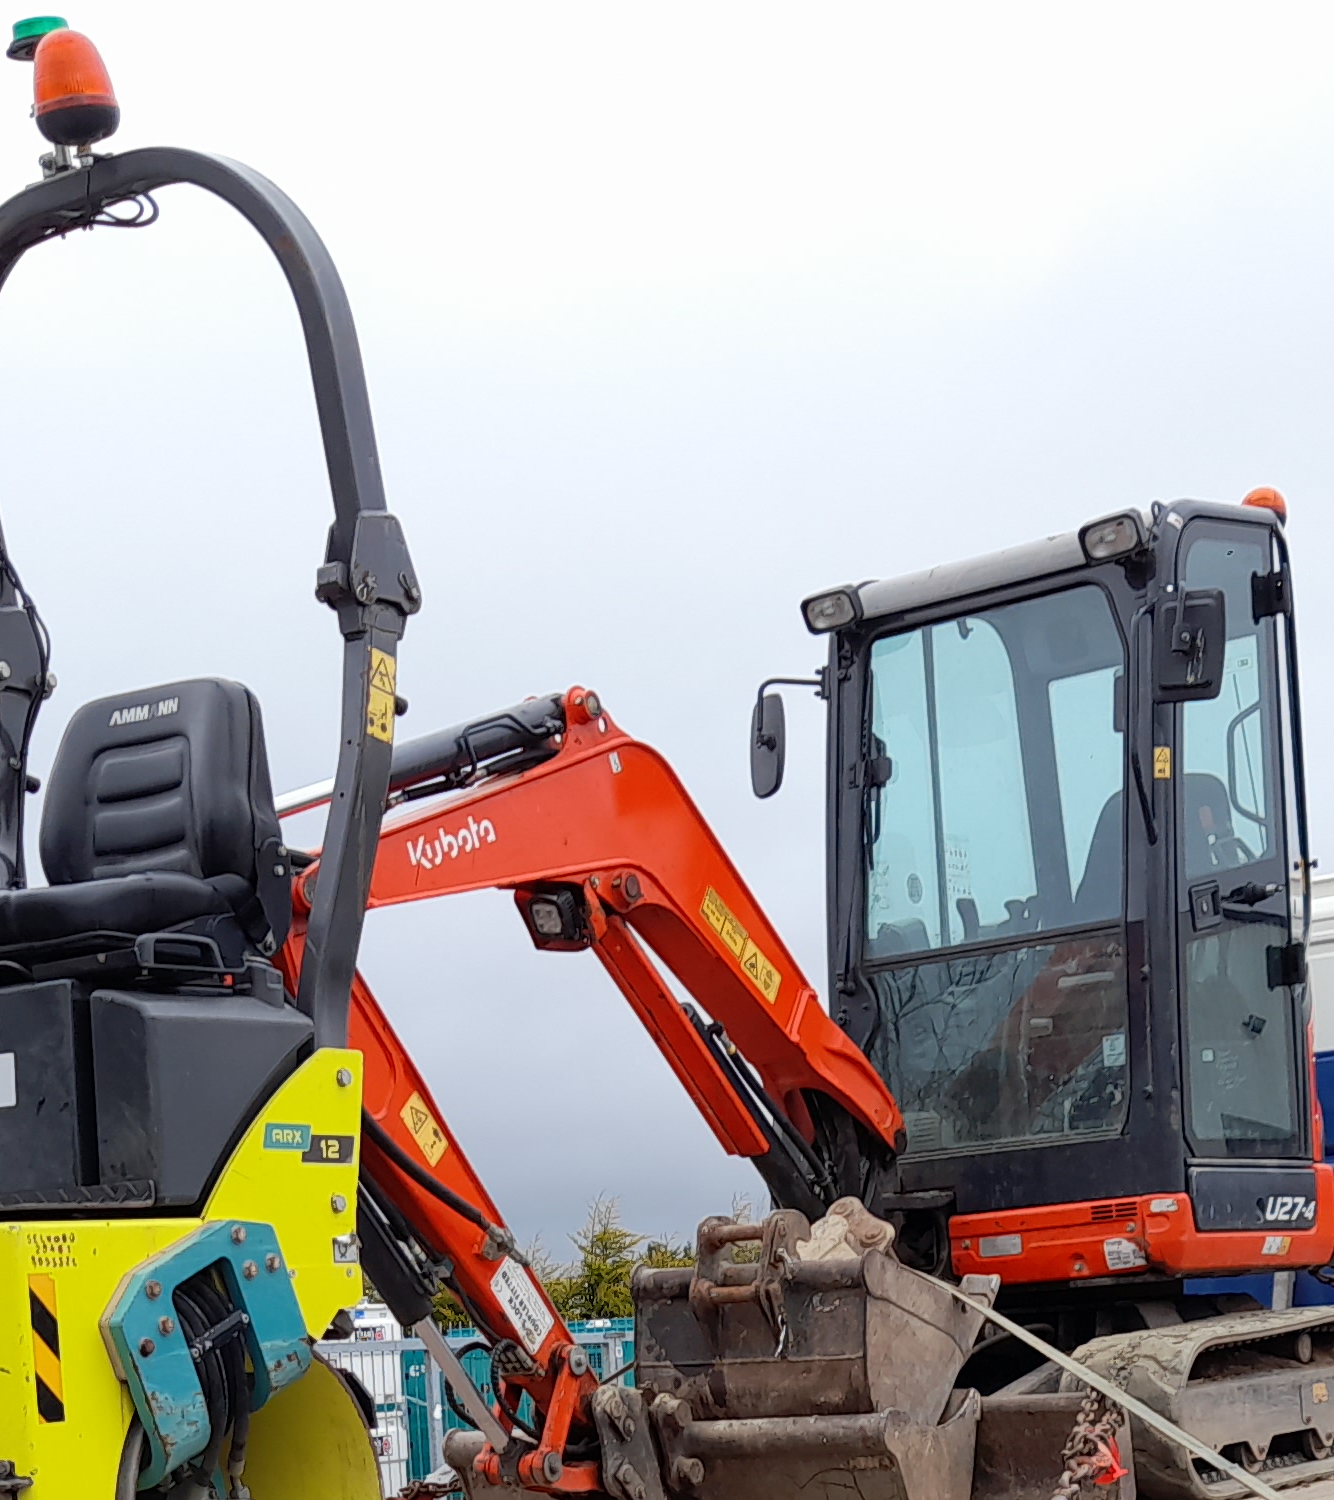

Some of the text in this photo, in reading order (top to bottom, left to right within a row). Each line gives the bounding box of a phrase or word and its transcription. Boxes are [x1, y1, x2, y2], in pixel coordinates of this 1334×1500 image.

[108, 696, 179, 727] AMMANN
[407, 815, 496, 870] Kubota
[271, 1128, 340, 1159] ARX 12
